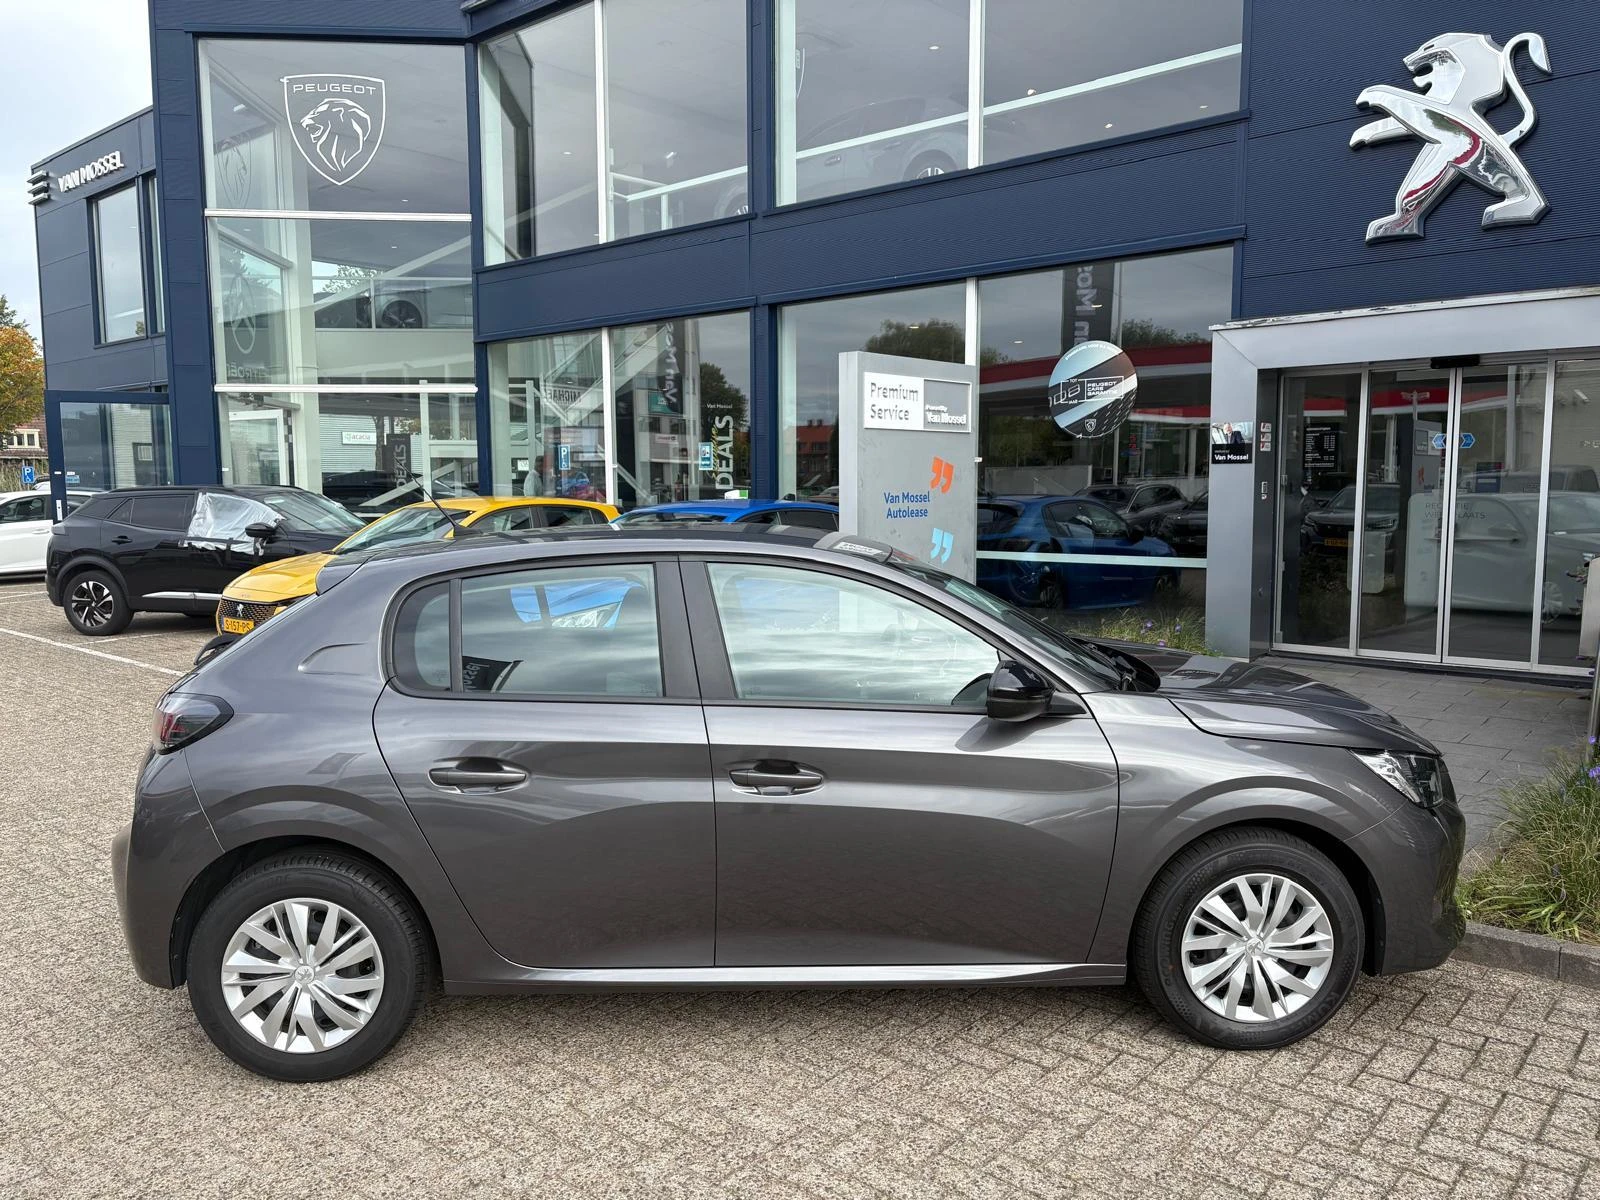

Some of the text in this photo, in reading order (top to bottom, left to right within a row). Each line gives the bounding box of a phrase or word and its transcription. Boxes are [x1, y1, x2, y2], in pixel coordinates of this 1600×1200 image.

[292, 83, 377, 96] PEUGEOT
[58, 150, 124, 192] VAN MOSSEL
[870, 382, 918, 402] Premium
[870, 404, 909, 420] Service
[926, 411, 967, 425] Van Mossel
[715, 415, 734, 489] DEALS
[25, 467, 32, 476] P
[884, 490, 930, 504] Van Mossel
[886, 506, 929, 519] Autolease
